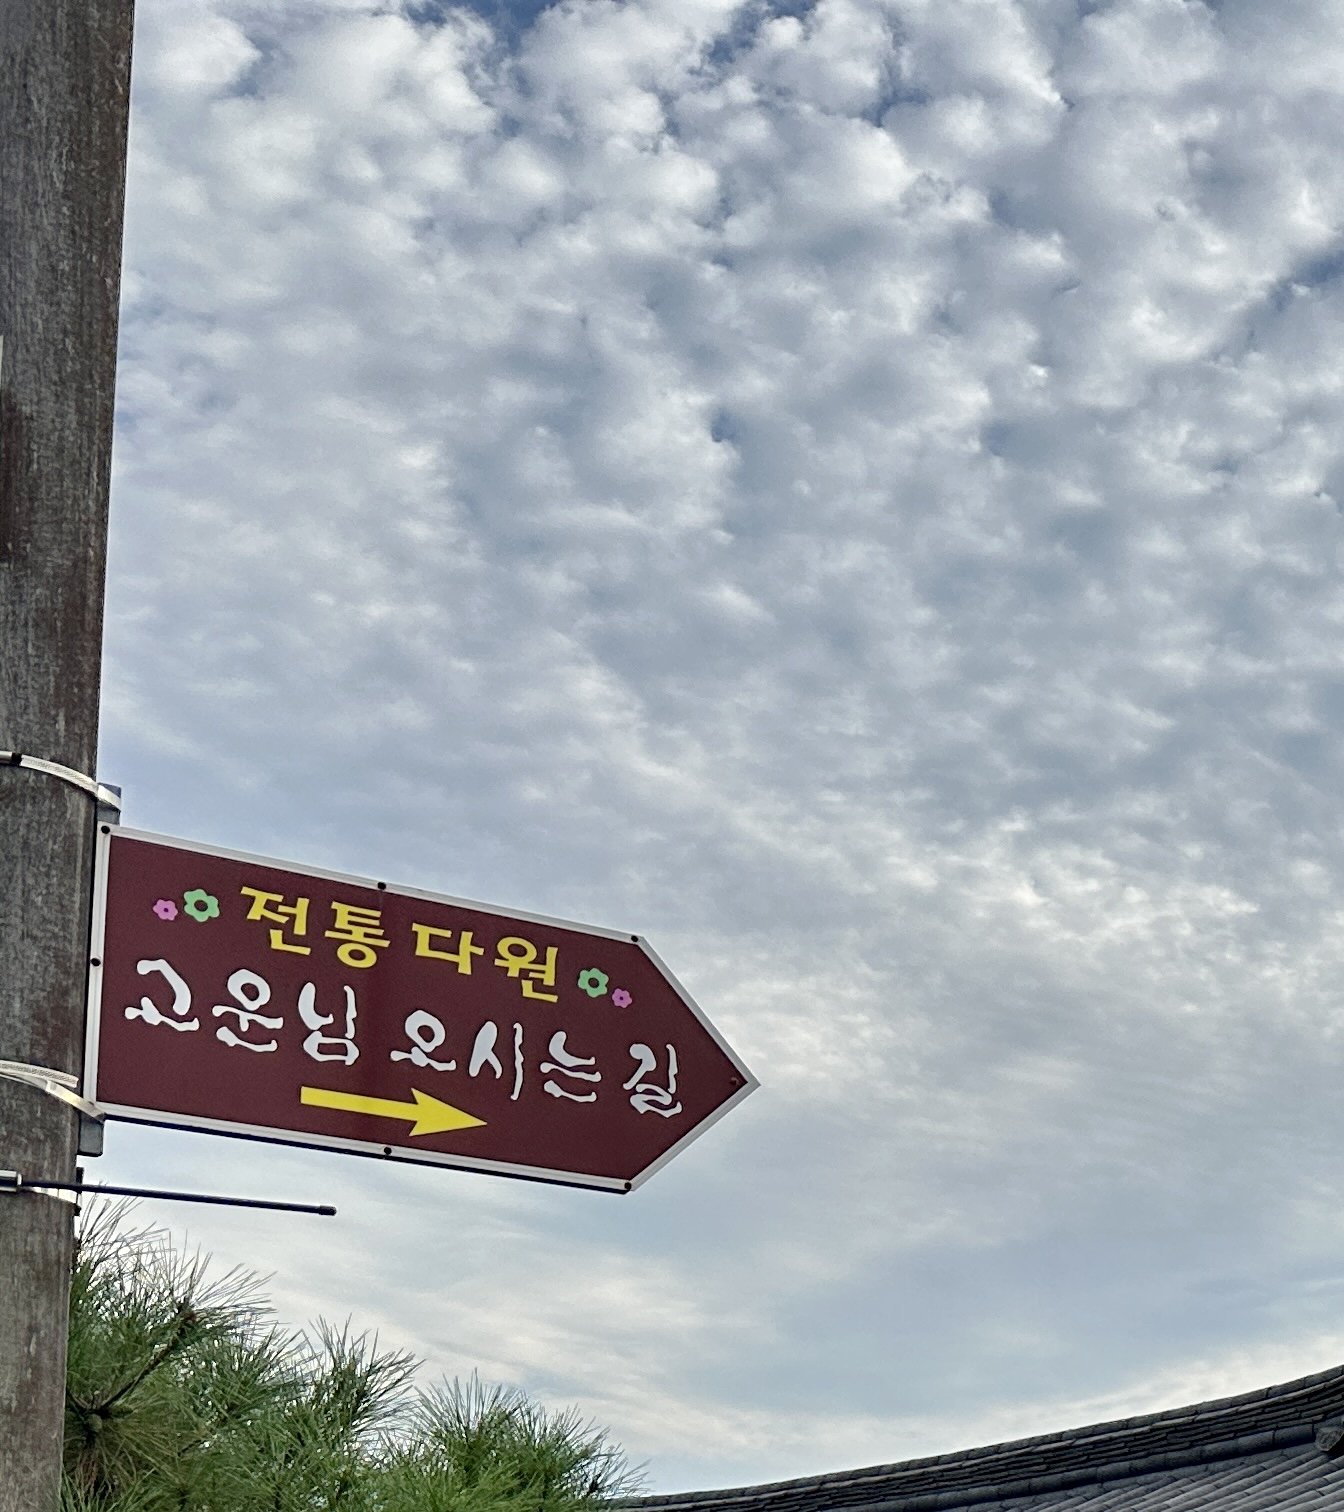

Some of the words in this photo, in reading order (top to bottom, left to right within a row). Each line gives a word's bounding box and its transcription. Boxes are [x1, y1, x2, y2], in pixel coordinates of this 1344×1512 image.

[242, 887, 390, 967] 전통
[411, 923, 558, 1002] 다원
[125, 959, 359, 1065] 고운님
[391, 1010, 601, 1102] 오시는
[622, 1043, 681, 1117] 길
